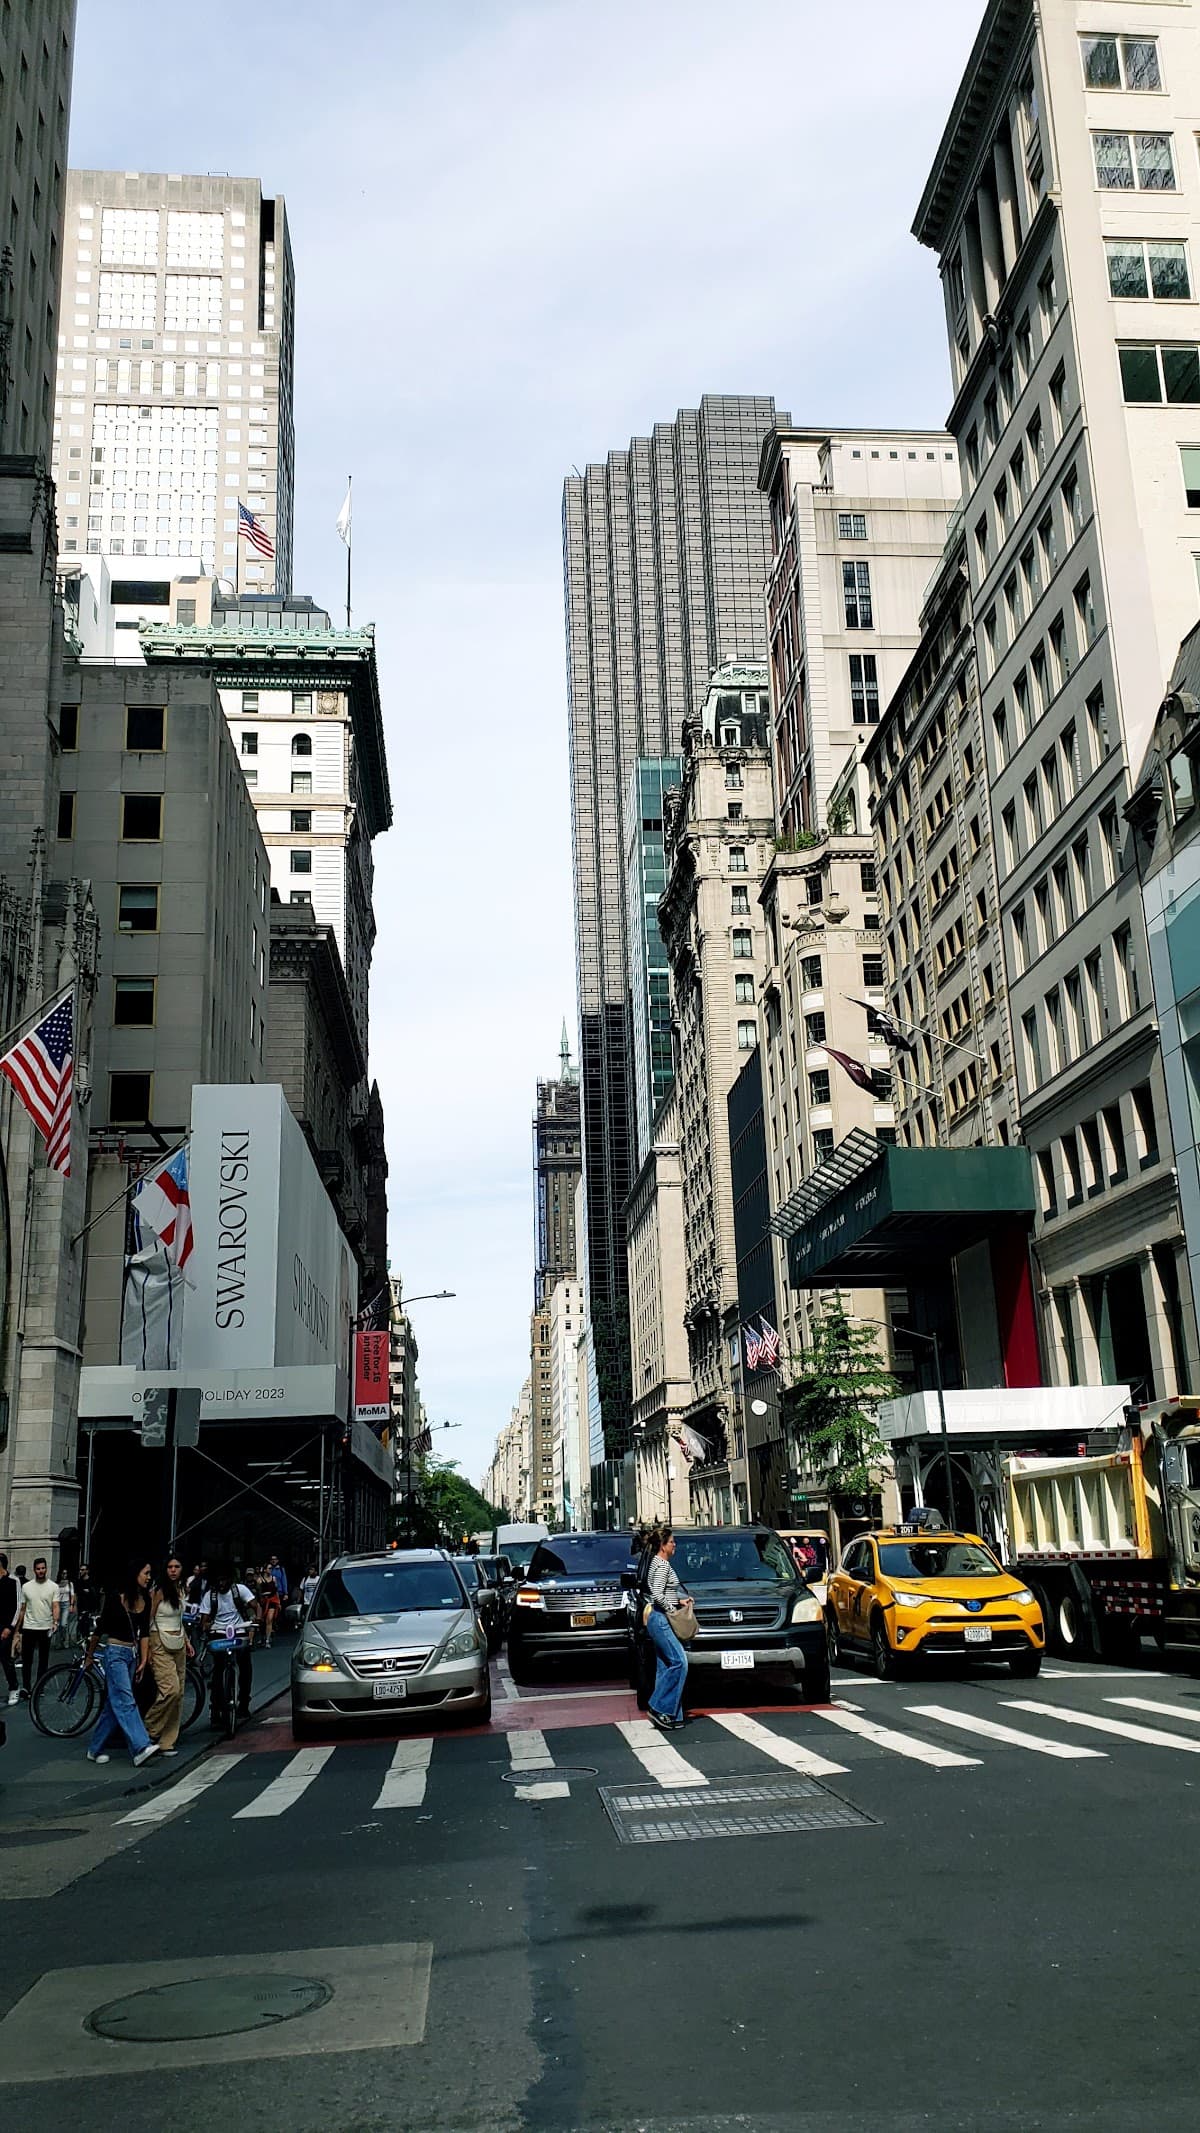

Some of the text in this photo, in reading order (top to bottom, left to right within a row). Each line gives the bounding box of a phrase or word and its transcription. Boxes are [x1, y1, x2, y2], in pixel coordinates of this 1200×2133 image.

[215, 1129, 250, 1329] SWAROVSKI
[363, 1335, 371, 1381] and under
[372, 1335, 381, 1383] Free for 16
[255, 1388, 285, 1400] 2023
[358, 1406, 387, 1416] MoMA
